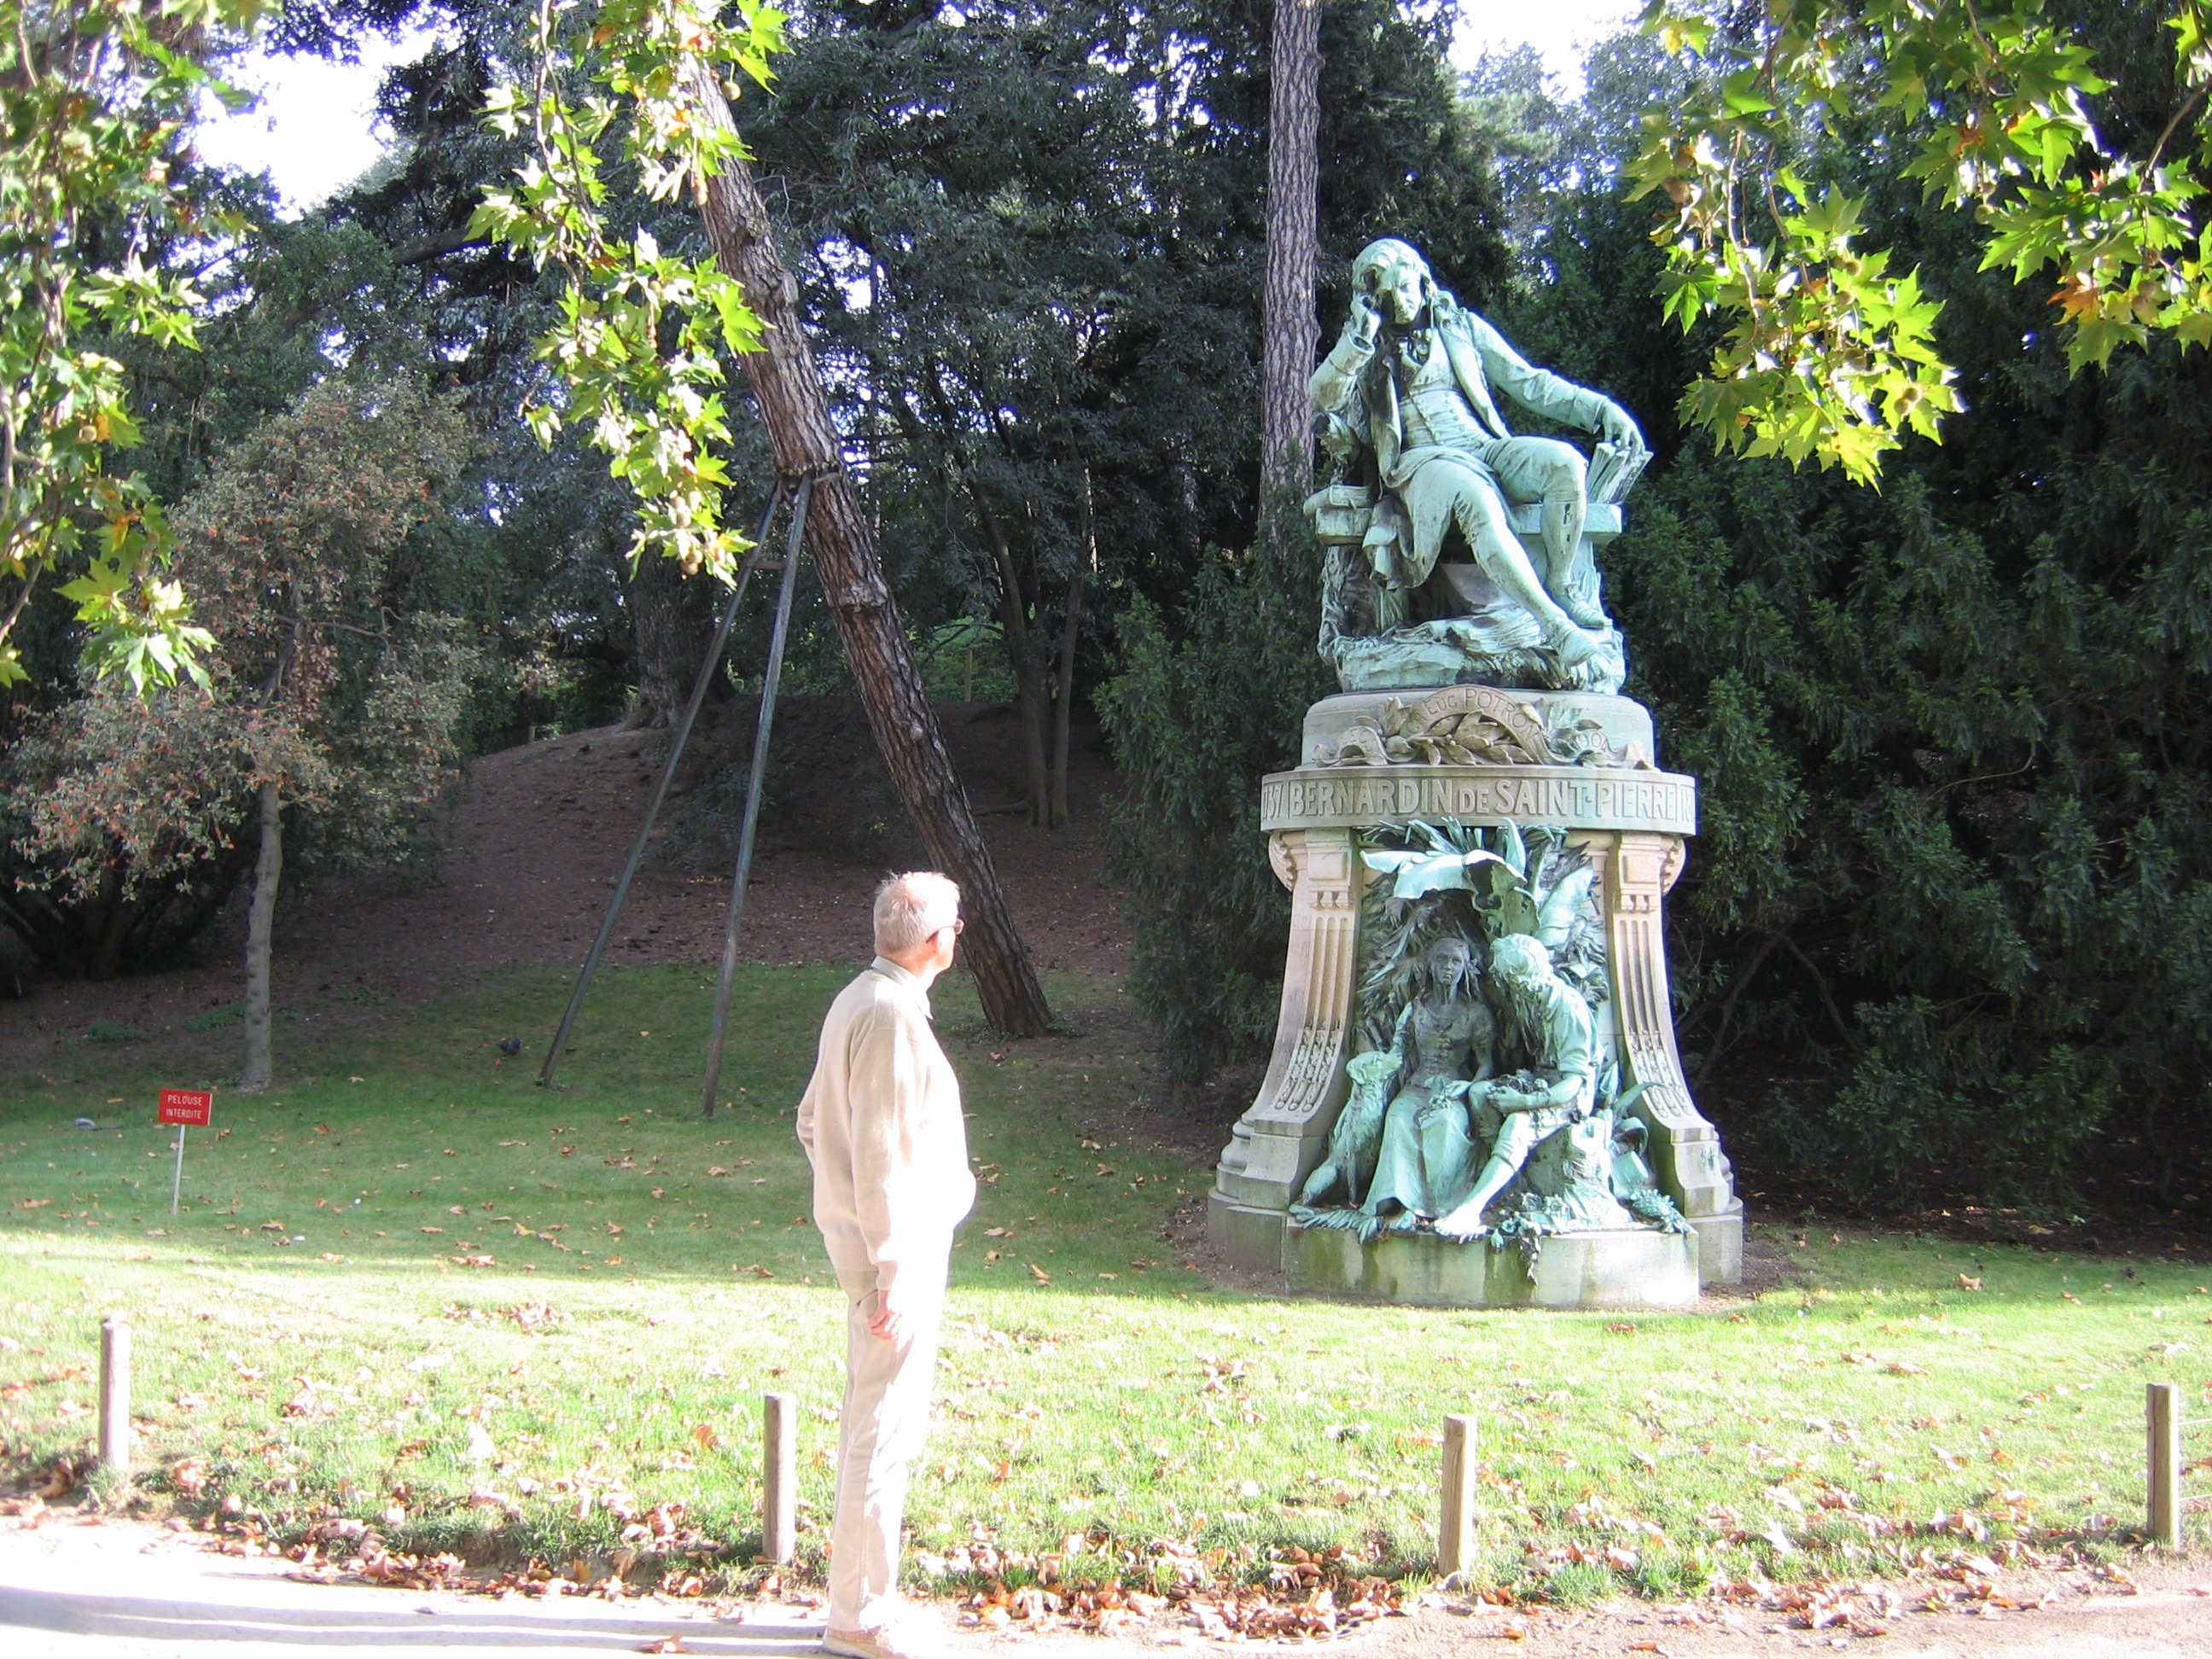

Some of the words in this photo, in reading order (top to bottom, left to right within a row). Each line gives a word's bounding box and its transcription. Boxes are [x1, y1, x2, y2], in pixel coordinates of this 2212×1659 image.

[1464, 687, 1538, 737] POTRON
[1289, 778, 1453, 817] BERNARDIN
[1459, 788, 1489, 813] DE
[1494, 779, 1676, 821] SAINT-PIERRE
[167, 1094, 202, 1106] PELOUSE
[165, 1108, 202, 1120] INTERDITE
